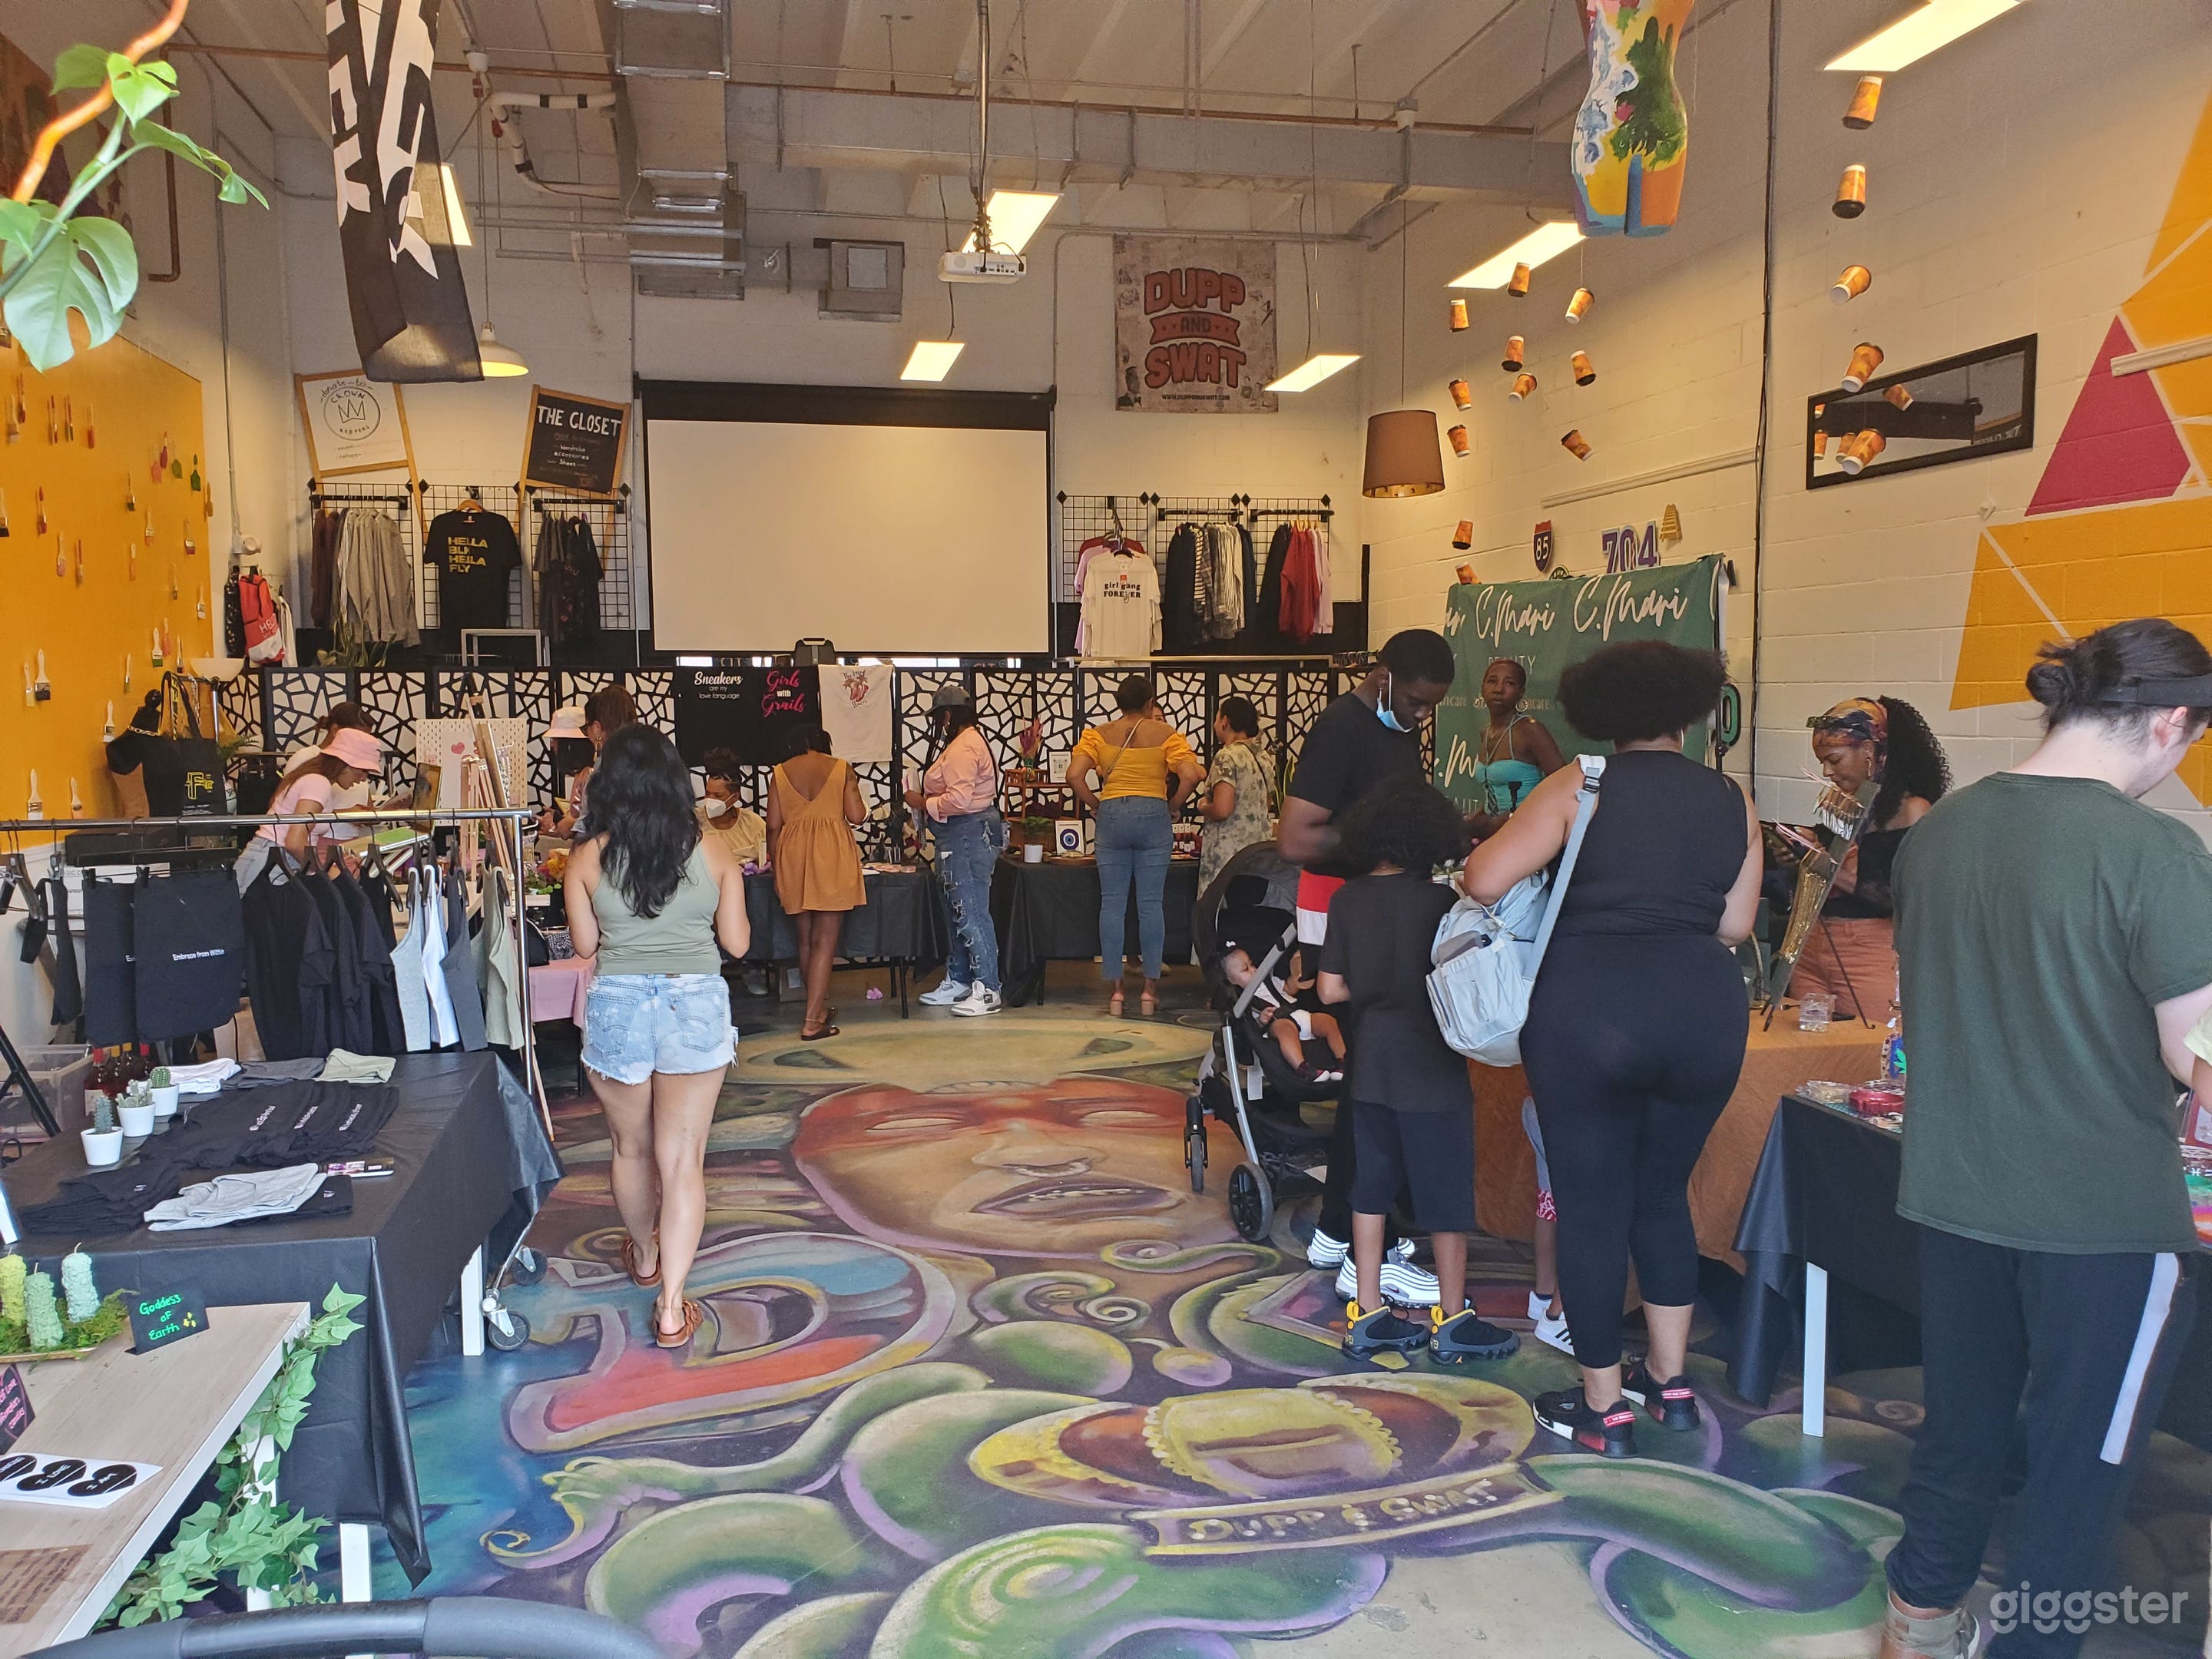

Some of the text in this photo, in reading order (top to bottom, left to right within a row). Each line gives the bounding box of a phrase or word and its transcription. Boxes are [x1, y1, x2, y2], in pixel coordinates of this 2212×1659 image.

[1144, 267, 1246, 315] DUPP
[1181, 316, 1211, 333] AND
[1144, 342, 1247, 389] SWAT
[330, 390, 366, 403] CROWN
[339, 425, 369, 435] KEEPERS
[538, 406, 622, 436] THE CLOSET
[448, 536, 488, 548] HELLA
[1536, 537, 1549, 562] 85
[1602, 522, 1659, 573] 704
[449, 555, 486, 566] HELLA
[449, 565, 471, 573] FLY
[1104, 581, 1119, 590] girl
[694, 671, 743, 685] Sneakers
[767, 670, 800, 691] Girls
[761, 693, 805, 717] Grails
[139, 1294, 182, 1315] Goddess
[148, 1323, 180, 1340] Earth
[1188, 1510, 1326, 1541] DUPP
